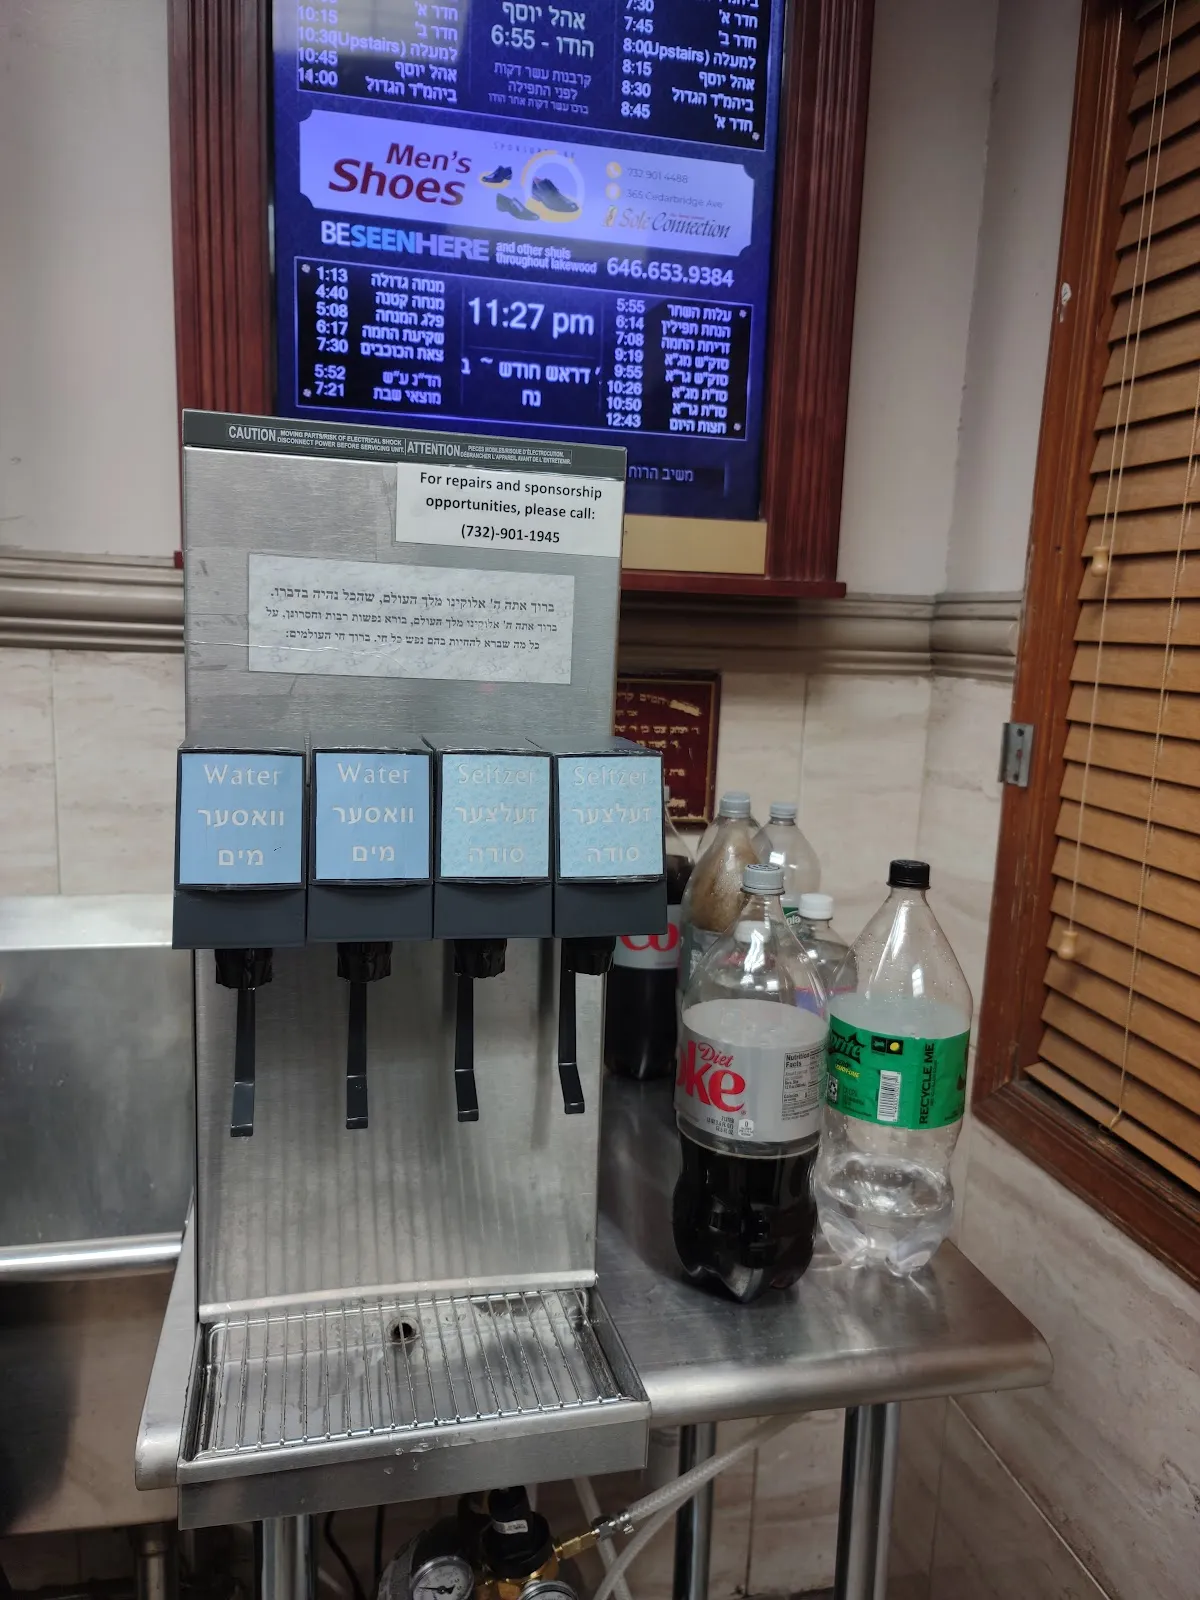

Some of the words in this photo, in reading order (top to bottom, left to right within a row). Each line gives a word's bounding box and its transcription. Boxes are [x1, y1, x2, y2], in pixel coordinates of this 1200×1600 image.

[297, 6, 338, 24] 10:15
[430, 6, 458, 21] חדר
[502, 1, 543, 25] יוסף
[548, 5, 586, 30] אהל
[734, 13, 758, 29] חדר
[623, 16, 653, 33] 7:45
[430, 26, 458, 41] חדר
[491, 24, 536, 50] 6:55
[733, 34, 757, 50] חדר
[410, 42, 457, 62] למעלה
[556, 36, 594, 58] הודו
[297, 48, 338, 66] 10:45
[713, 52, 756, 70] למעלה
[394, 61, 425, 78] יוסף
[430, 65, 457, 83] אהל
[622, 59, 652, 76] 8:15
[297, 68, 338, 87] 14:00
[365, 76, 406, 96] הגדול
[698, 71, 727, 89] יוסף
[729, 74, 755, 91] אהל
[508, 80, 551, 97] התפילה
[621, 80, 651, 98] 8:30
[671, 87, 708, 106] הגדול
[620, 101, 651, 120] 8:45
[729, 117, 752, 133] חדר
[385, 142, 472, 174] Men's
[328, 158, 466, 206] Shoes
[627, 167, 643, 178] 732
[645, 170, 661, 180] 901
[664, 173, 688, 184] 4488
[626, 189, 643, 199] 365
[645, 191, 704, 208] Cedarbridge
[652, 212, 731, 239] Connection
[496, 242, 517, 253] and
[517, 244, 544, 256] other
[496, 253, 550, 269] throughout
[551, 258, 597, 274] lakewood
[316, 266, 348, 283] 1:13
[371, 273, 409, 289] גדולה
[606, 257, 735, 288] 646.653.9384
[315, 284, 348, 301] 4:40
[411, 278, 445, 293] מנחה
[375, 291, 409, 309] קטנה
[411, 295, 445, 311] מנחה
[616, 298, 645, 314] 5:55
[315, 301, 348, 318] 5:08
[375, 309, 418, 326] המנחה
[468, 297, 545, 330] 11:27
[552, 311, 595, 339] pm
[667, 304, 700, 319] השחר
[703, 308, 733, 323] עלות
[316, 319, 348, 335] 6:17
[420, 314, 444, 328] פלג
[615, 316, 644, 331] 6:14
[661, 320, 699, 336] תפילין
[362, 325, 400, 342] החמה
[402, 331, 445, 348] שקיעת
[615, 331, 644, 347] 7:08
[701, 324, 731, 339] הנחת
[316, 337, 349, 354] 7:30
[360, 342, 414, 360] הכוכבים
[661, 337, 695, 352] החמה
[416, 347, 445, 363] צאת
[614, 347, 644, 363] 9:19
[314, 364, 346, 381] 5:52
[498, 361, 541, 381] חודש
[545, 365, 591, 384] דראש
[614, 364, 644, 380] 9:55
[314, 381, 345, 398] 7:21
[373, 386, 402, 402] שבת
[606, 379, 643, 396] 10:26
[405, 390, 442, 406] מוצאי
[521, 389, 542, 407] נח
[606, 396, 642, 412] 10:50
[605, 412, 642, 429] 12:43
[669, 418, 696, 432] היום
[697, 420, 727, 434] חצות
[228, 425, 276, 442] CAUTION
[280, 430, 303, 438] MOVING
[304, 432, 337, 441] PARTS/RISK
[338, 434, 346, 442] OF
[347, 435, 381, 445] ELECTRICAL
[382, 438, 402, 446] SHOCK
[277, 437, 315, 446] DISCONNECT
[315, 440, 336, 448] POWER
[336, 442, 359, 450] BEFORE
[360, 444, 390, 453] SERVICING
[407, 441, 461, 458] ATTENTION
[628, 466, 659, 480] הרוח
[662, 468, 694, 482] משיב
[420, 472, 442, 484] For
[446, 475, 493, 490] repairs
[496, 480, 521, 492] and
[524, 482, 602, 501] sponsorship
[425, 497, 521, 516] opportunities,
[524, 503, 566, 518] please
[569, 507, 596, 520] call:
[461, 524, 560, 543] (732)-901-1945
[270, 587, 309, 598] בדברו.
[312, 589, 339, 600] נהיה
[342, 588, 375, 602] שהכל
[379, 591, 418, 605] העולם,
[421, 593, 443, 608] מלך
[265, 606, 279, 617] על
[446, 596, 486, 610] אלוקינו
[504, 601, 527, 611] אתה
[531, 602, 555, 614] ברוך
[325, 612, 348, 621] רבות
[351, 613, 381, 623] נפשות
[384, 615, 407, 624] בורא
[410, 615, 442, 627] העולם,
[445, 616, 463, 628] מלך
[286, 628, 332, 640] העולמים:
[515, 622, 534, 631] אתה
[537, 623, 558, 632] ברוך
[335, 632, 346, 641] חי
[348, 633, 371, 643] ברוך
[391, 633, 402, 644] כל
[405, 635, 424, 645] נפש
[427, 637, 446, 646] בהם
[449, 637, 481, 648] להחיות
[484, 640, 511, 649] שברא
[529, 639, 540, 650] כל
[513, 641, 526, 650] מה
[203, 763, 282, 787] Water
[337, 762, 411, 785] Water
[457, 762, 537, 786] Seltzer
[573, 764, 649, 787] Seltzer
[197, 808, 285, 829] וואסער
[332, 806, 415, 825] וואסער
[454, 802, 538, 825] זעלצער
[572, 803, 652, 825] זעלצער
[218, 848, 264, 866] מים
[352, 844, 395, 863] מים
[585, 846, 640, 863] סודה
[697, 1041, 735, 1068] Diet
[924, 1042, 935, 1063] ME
[785, 1060, 802, 1069] Facts
[919, 1066, 933, 1125] RECYCLE
